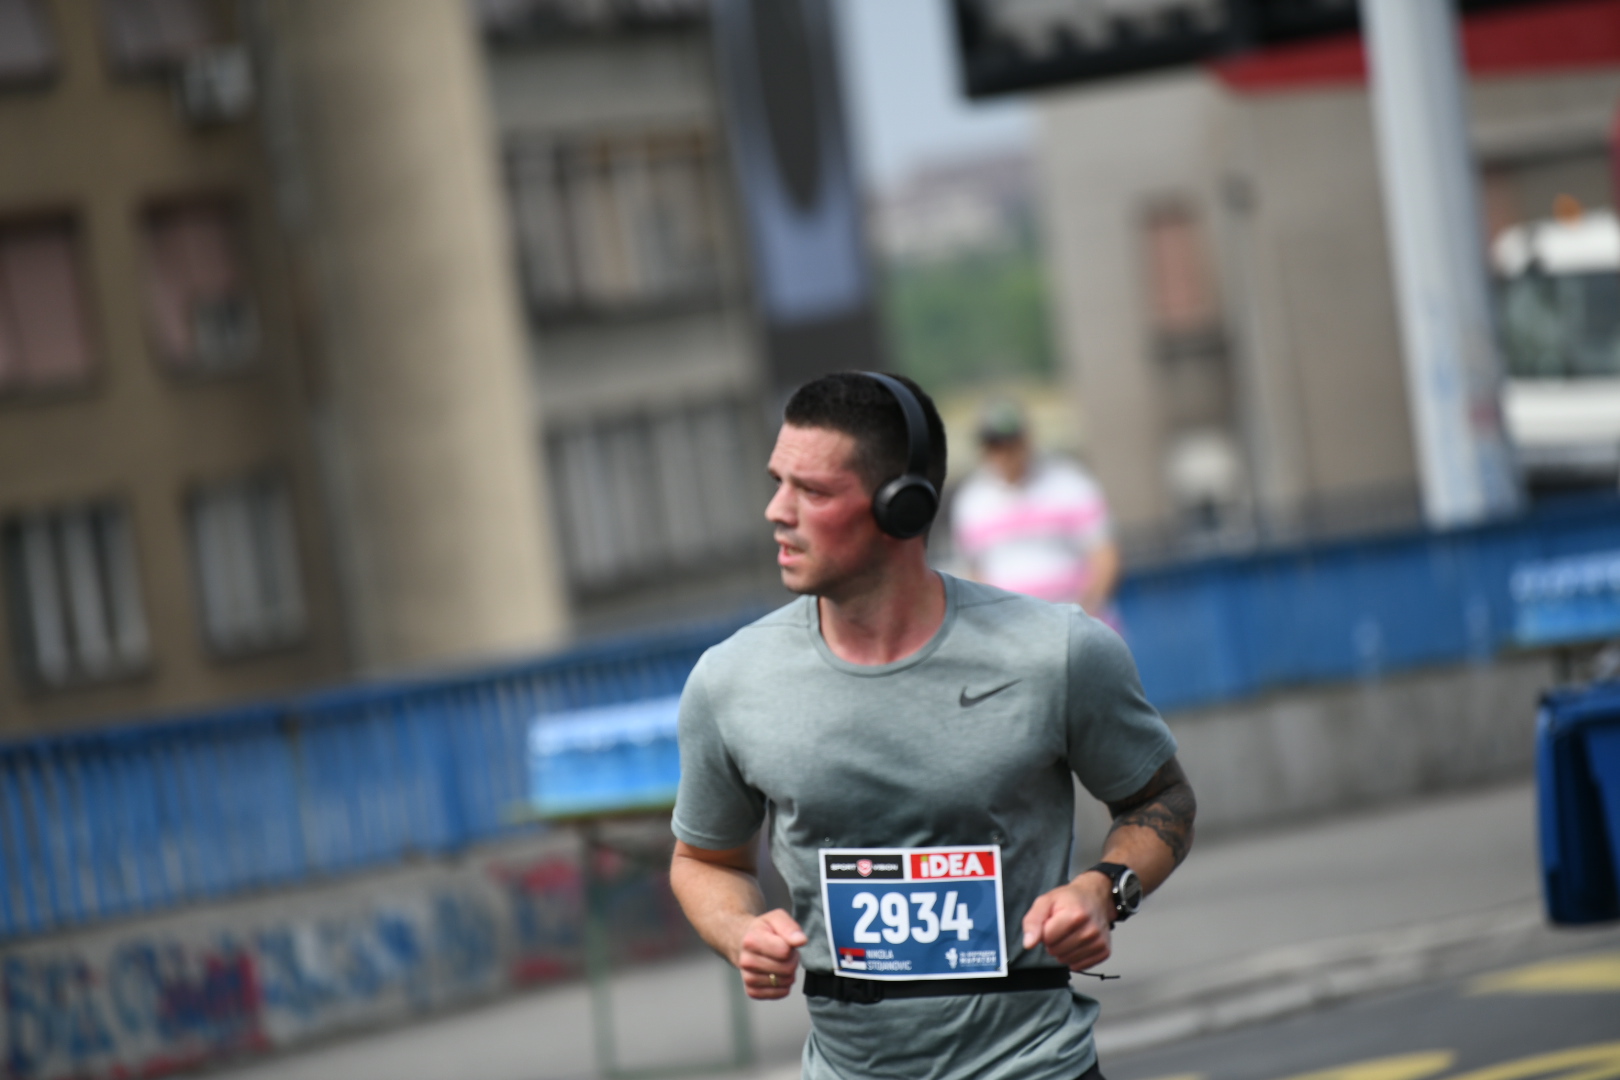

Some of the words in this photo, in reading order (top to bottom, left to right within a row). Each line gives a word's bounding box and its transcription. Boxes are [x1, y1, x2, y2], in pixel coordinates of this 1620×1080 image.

[830, 863, 856, 871] SPORT
[873, 862, 899, 871] VISION
[851, 890, 974, 944] 2934
[865, 949, 894, 959] NIKOLA
